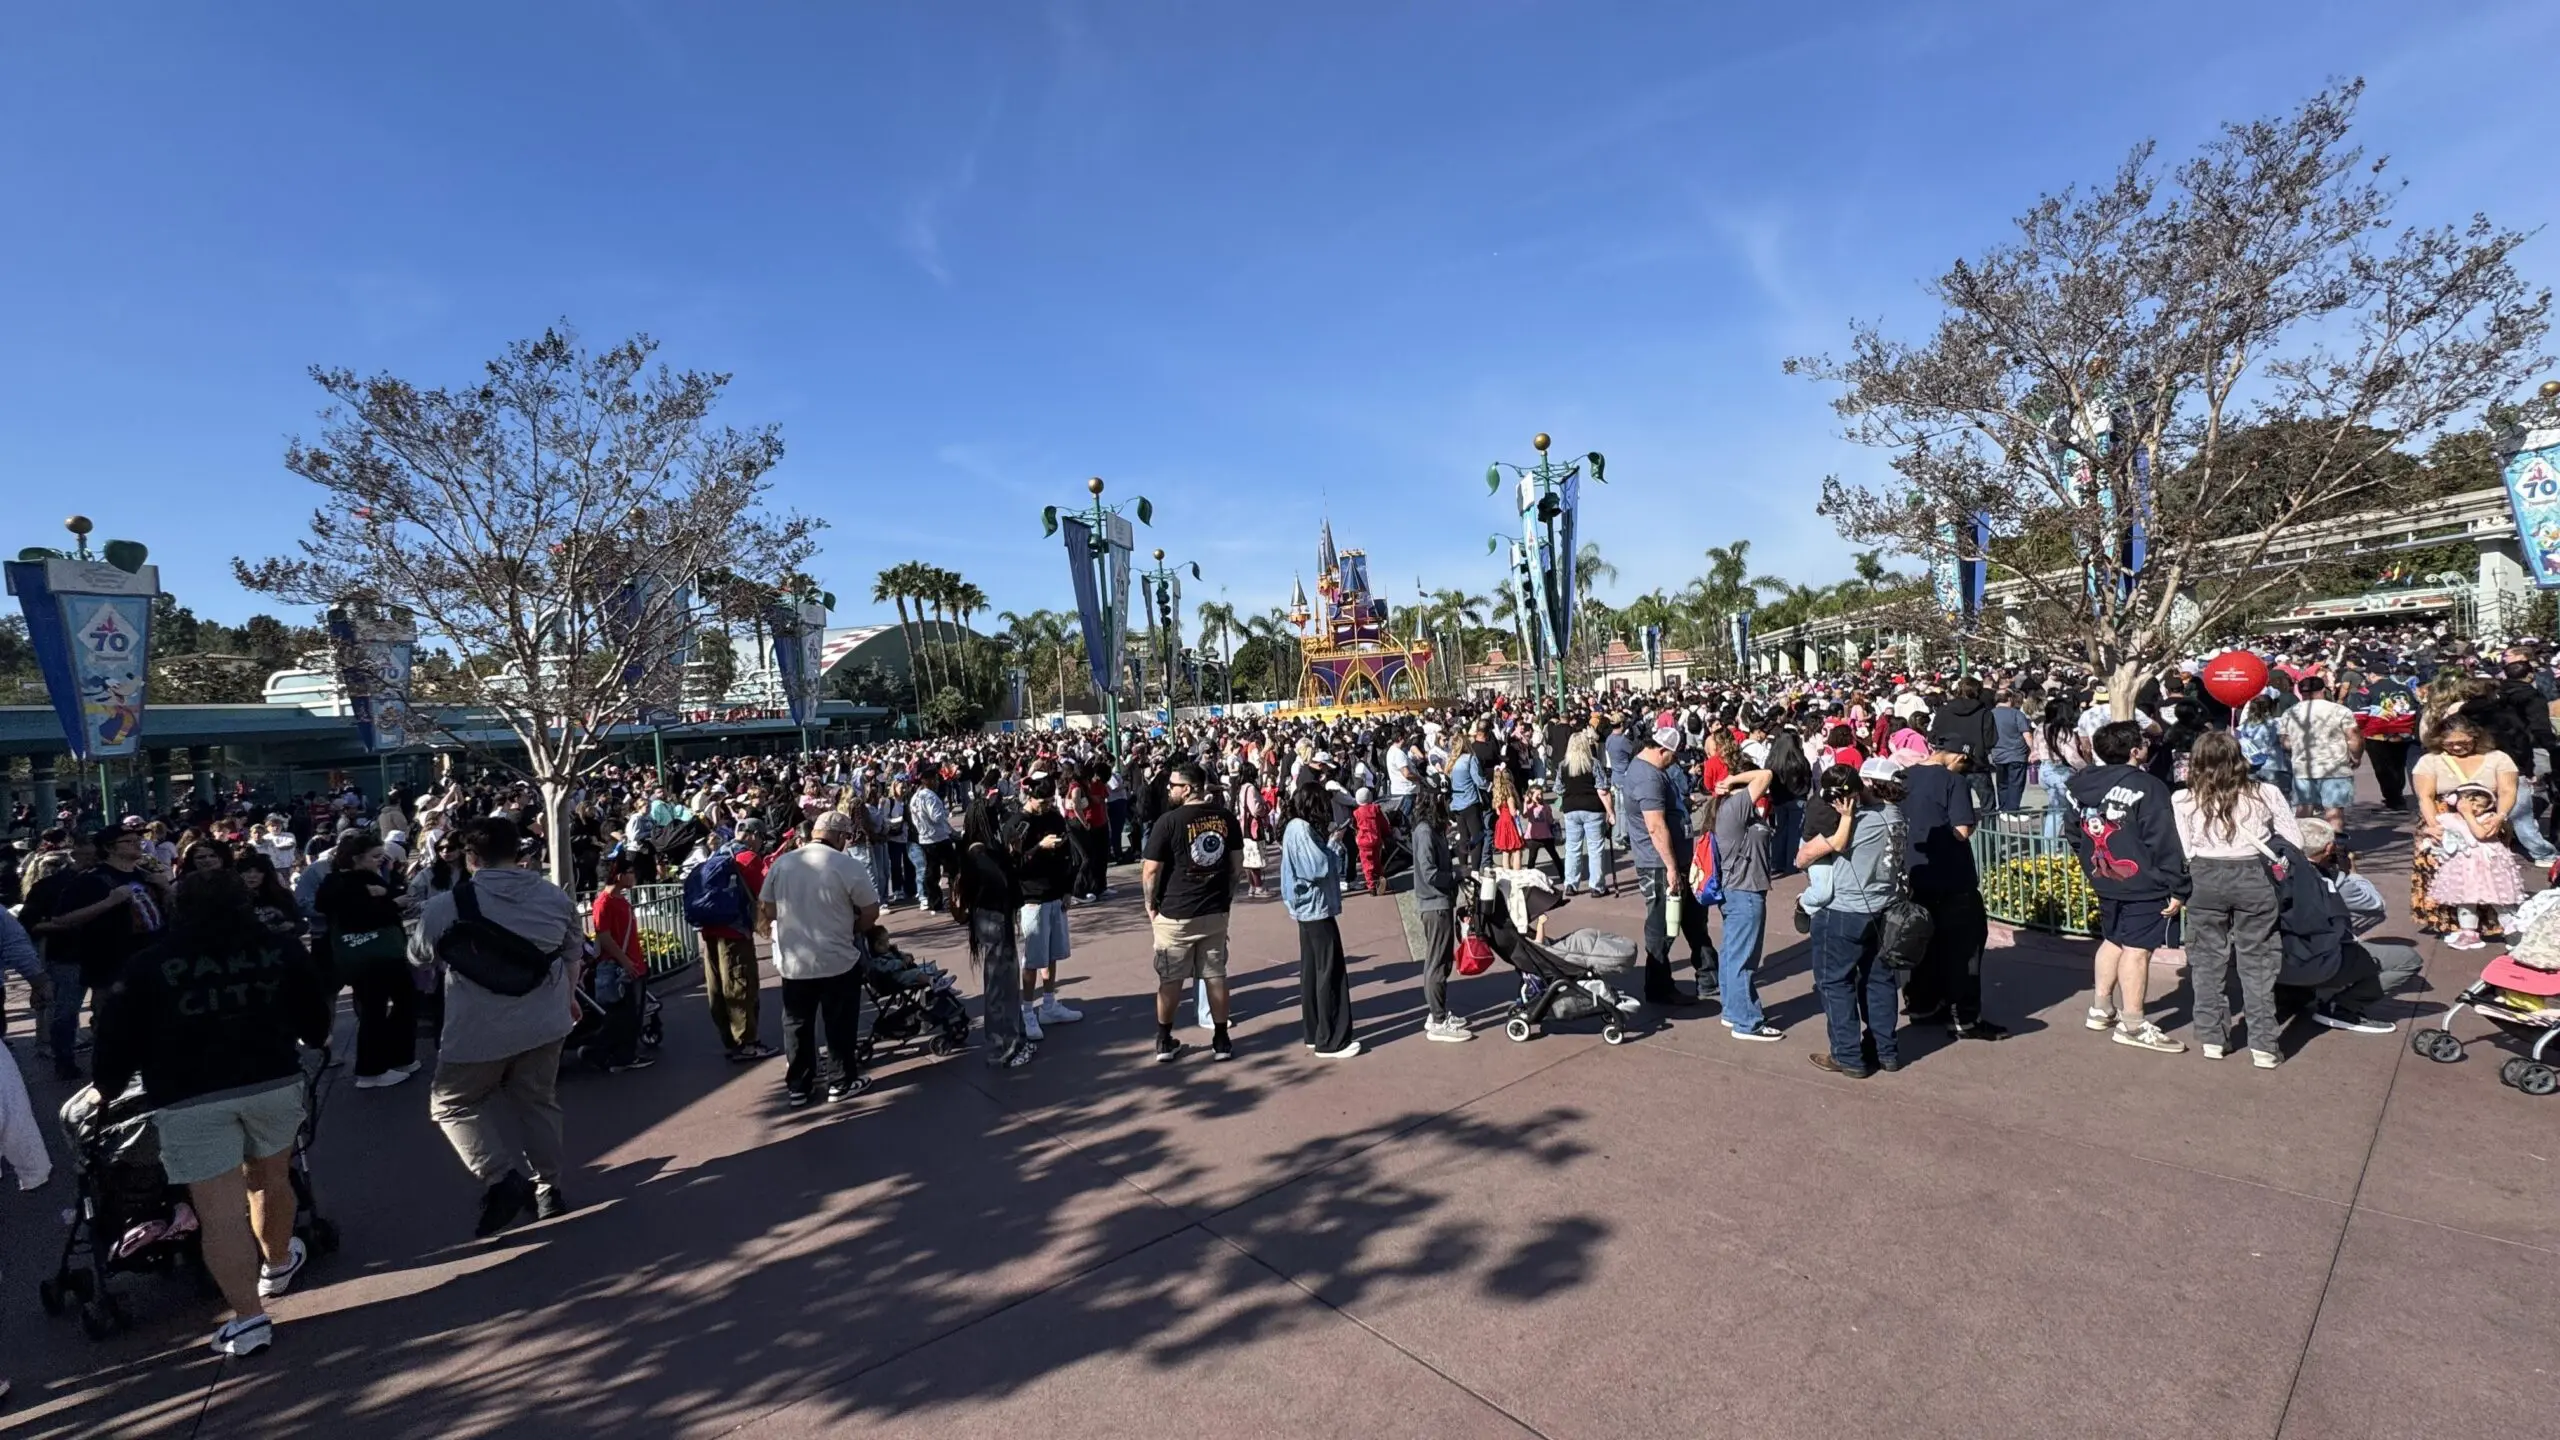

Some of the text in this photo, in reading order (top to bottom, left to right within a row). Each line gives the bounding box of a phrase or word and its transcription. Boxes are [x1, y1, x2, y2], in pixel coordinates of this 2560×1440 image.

[2523, 479, 2557, 498] 70
[89, 632, 129, 652] 70
[808, 647, 818, 660] 70
[160, 946, 285, 986] PARK
[178, 979, 281, 1016] CITY
